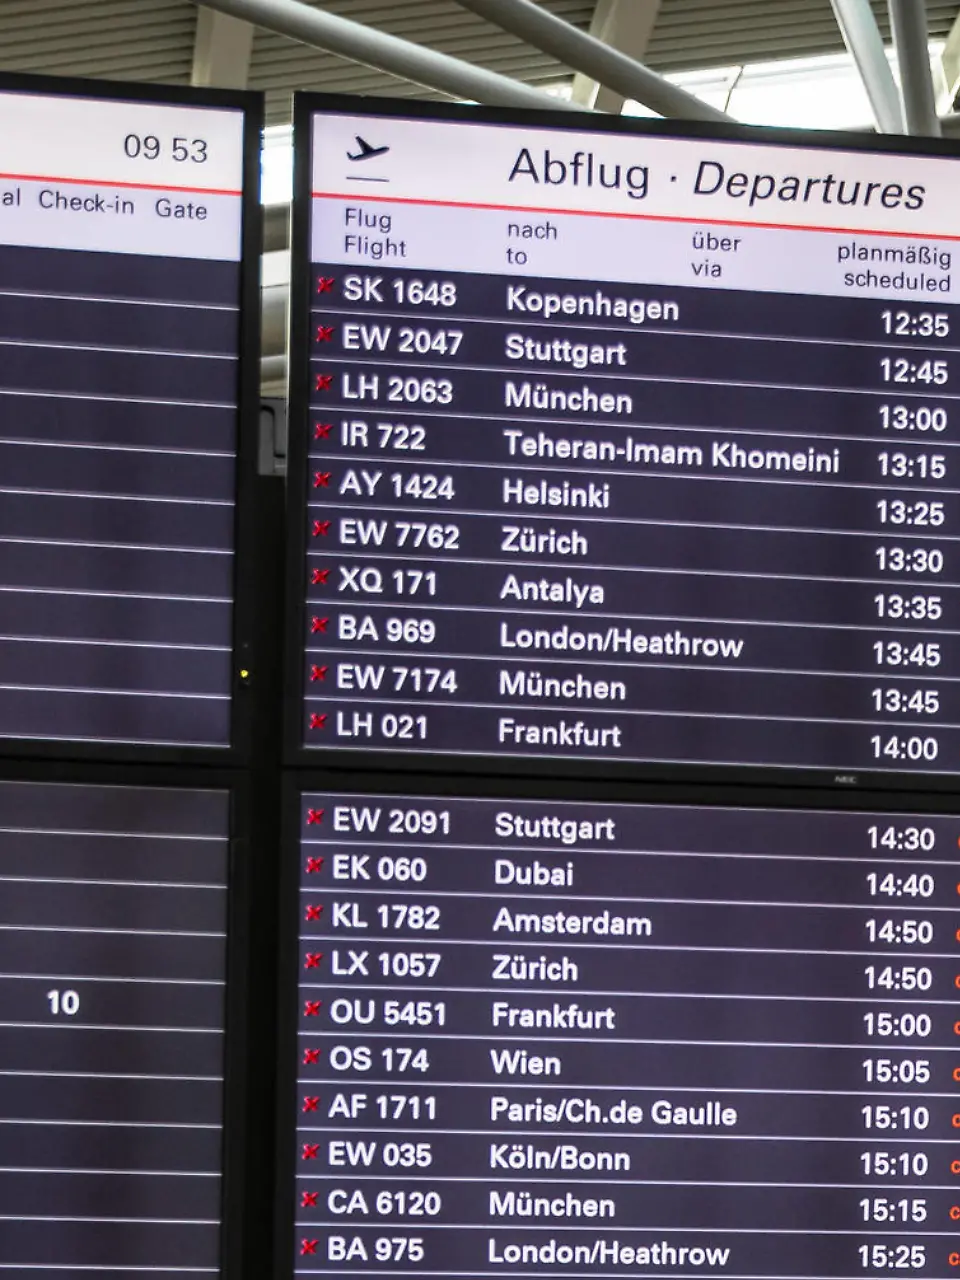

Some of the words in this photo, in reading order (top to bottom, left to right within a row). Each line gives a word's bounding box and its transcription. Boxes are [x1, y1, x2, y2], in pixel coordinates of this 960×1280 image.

[124, 134, 160, 160] 09
[172, 137, 207, 163] 53
[38, 189, 134, 214] Check-in
[155, 198, 207, 221] Gate
[508, 148, 649, 200] Abflug
[693, 160, 926, 210] Departures
[344, 207, 392, 234] Flug
[508, 221, 557, 240] nach
[692, 232, 741, 252] über
[837, 241, 952, 271] planmäßig
[344, 234, 407, 261] Flight
[506, 247, 528, 265] to
[691, 259, 722, 278] via
[843, 268, 952, 293] scheduled
[343, 274, 384, 303] SK
[393, 279, 457, 307] 1648
[506, 285, 679, 324] Kopenhagen
[881, 310, 950, 338] 12:35
[342, 323, 392, 352] EW
[398, 327, 464, 356] 2047
[505, 333, 628, 369] Stuttgart
[880, 357, 949, 385] 12:45
[341, 420, 369, 448] IR
[376, 423, 426, 451] 722
[503, 429, 703, 466] Teheran-Imam
[711, 441, 840, 474] Khomeini
[877, 451, 947, 479] 13:15
[339, 518, 388, 546] EW
[394, 521, 460, 550] 7762
[500, 525, 588, 556] Zürich
[875, 546, 944, 574] 13:30
[338, 614, 380, 642] BA
[386, 617, 436, 644] 969
[500, 621, 744, 658] London/Heathrow
[873, 640, 941, 668] 13:45
[336, 710, 373, 737] LH
[381, 713, 427, 740] 021
[498, 717, 622, 748] Frankfurt
[870, 734, 939, 761] 14:00
[333, 806, 382, 833] EW
[388, 808, 450, 835] 2091
[494, 811, 616, 845] Stuttgart
[867, 825, 936, 851] 14:30
[331, 949, 370, 976] LX
[378, 951, 442, 978] 1057
[491, 953, 579, 982] Zürich
[864, 965, 933, 991] 14:50
[47, 989, 80, 1015] 10
[327, 1092, 368, 1119] AF
[375, 1094, 436, 1120] 1711
[490, 1096, 644, 1125] Paris/Ch.de
[650, 1099, 738, 1127] Gaulle
[861, 1105, 930, 1130] 15:10
[327, 1188, 370, 1215] CA
[375, 1190, 442, 1216] 6120
[489, 1190, 616, 1218] München
[859, 1198, 928, 1223] 15:15
